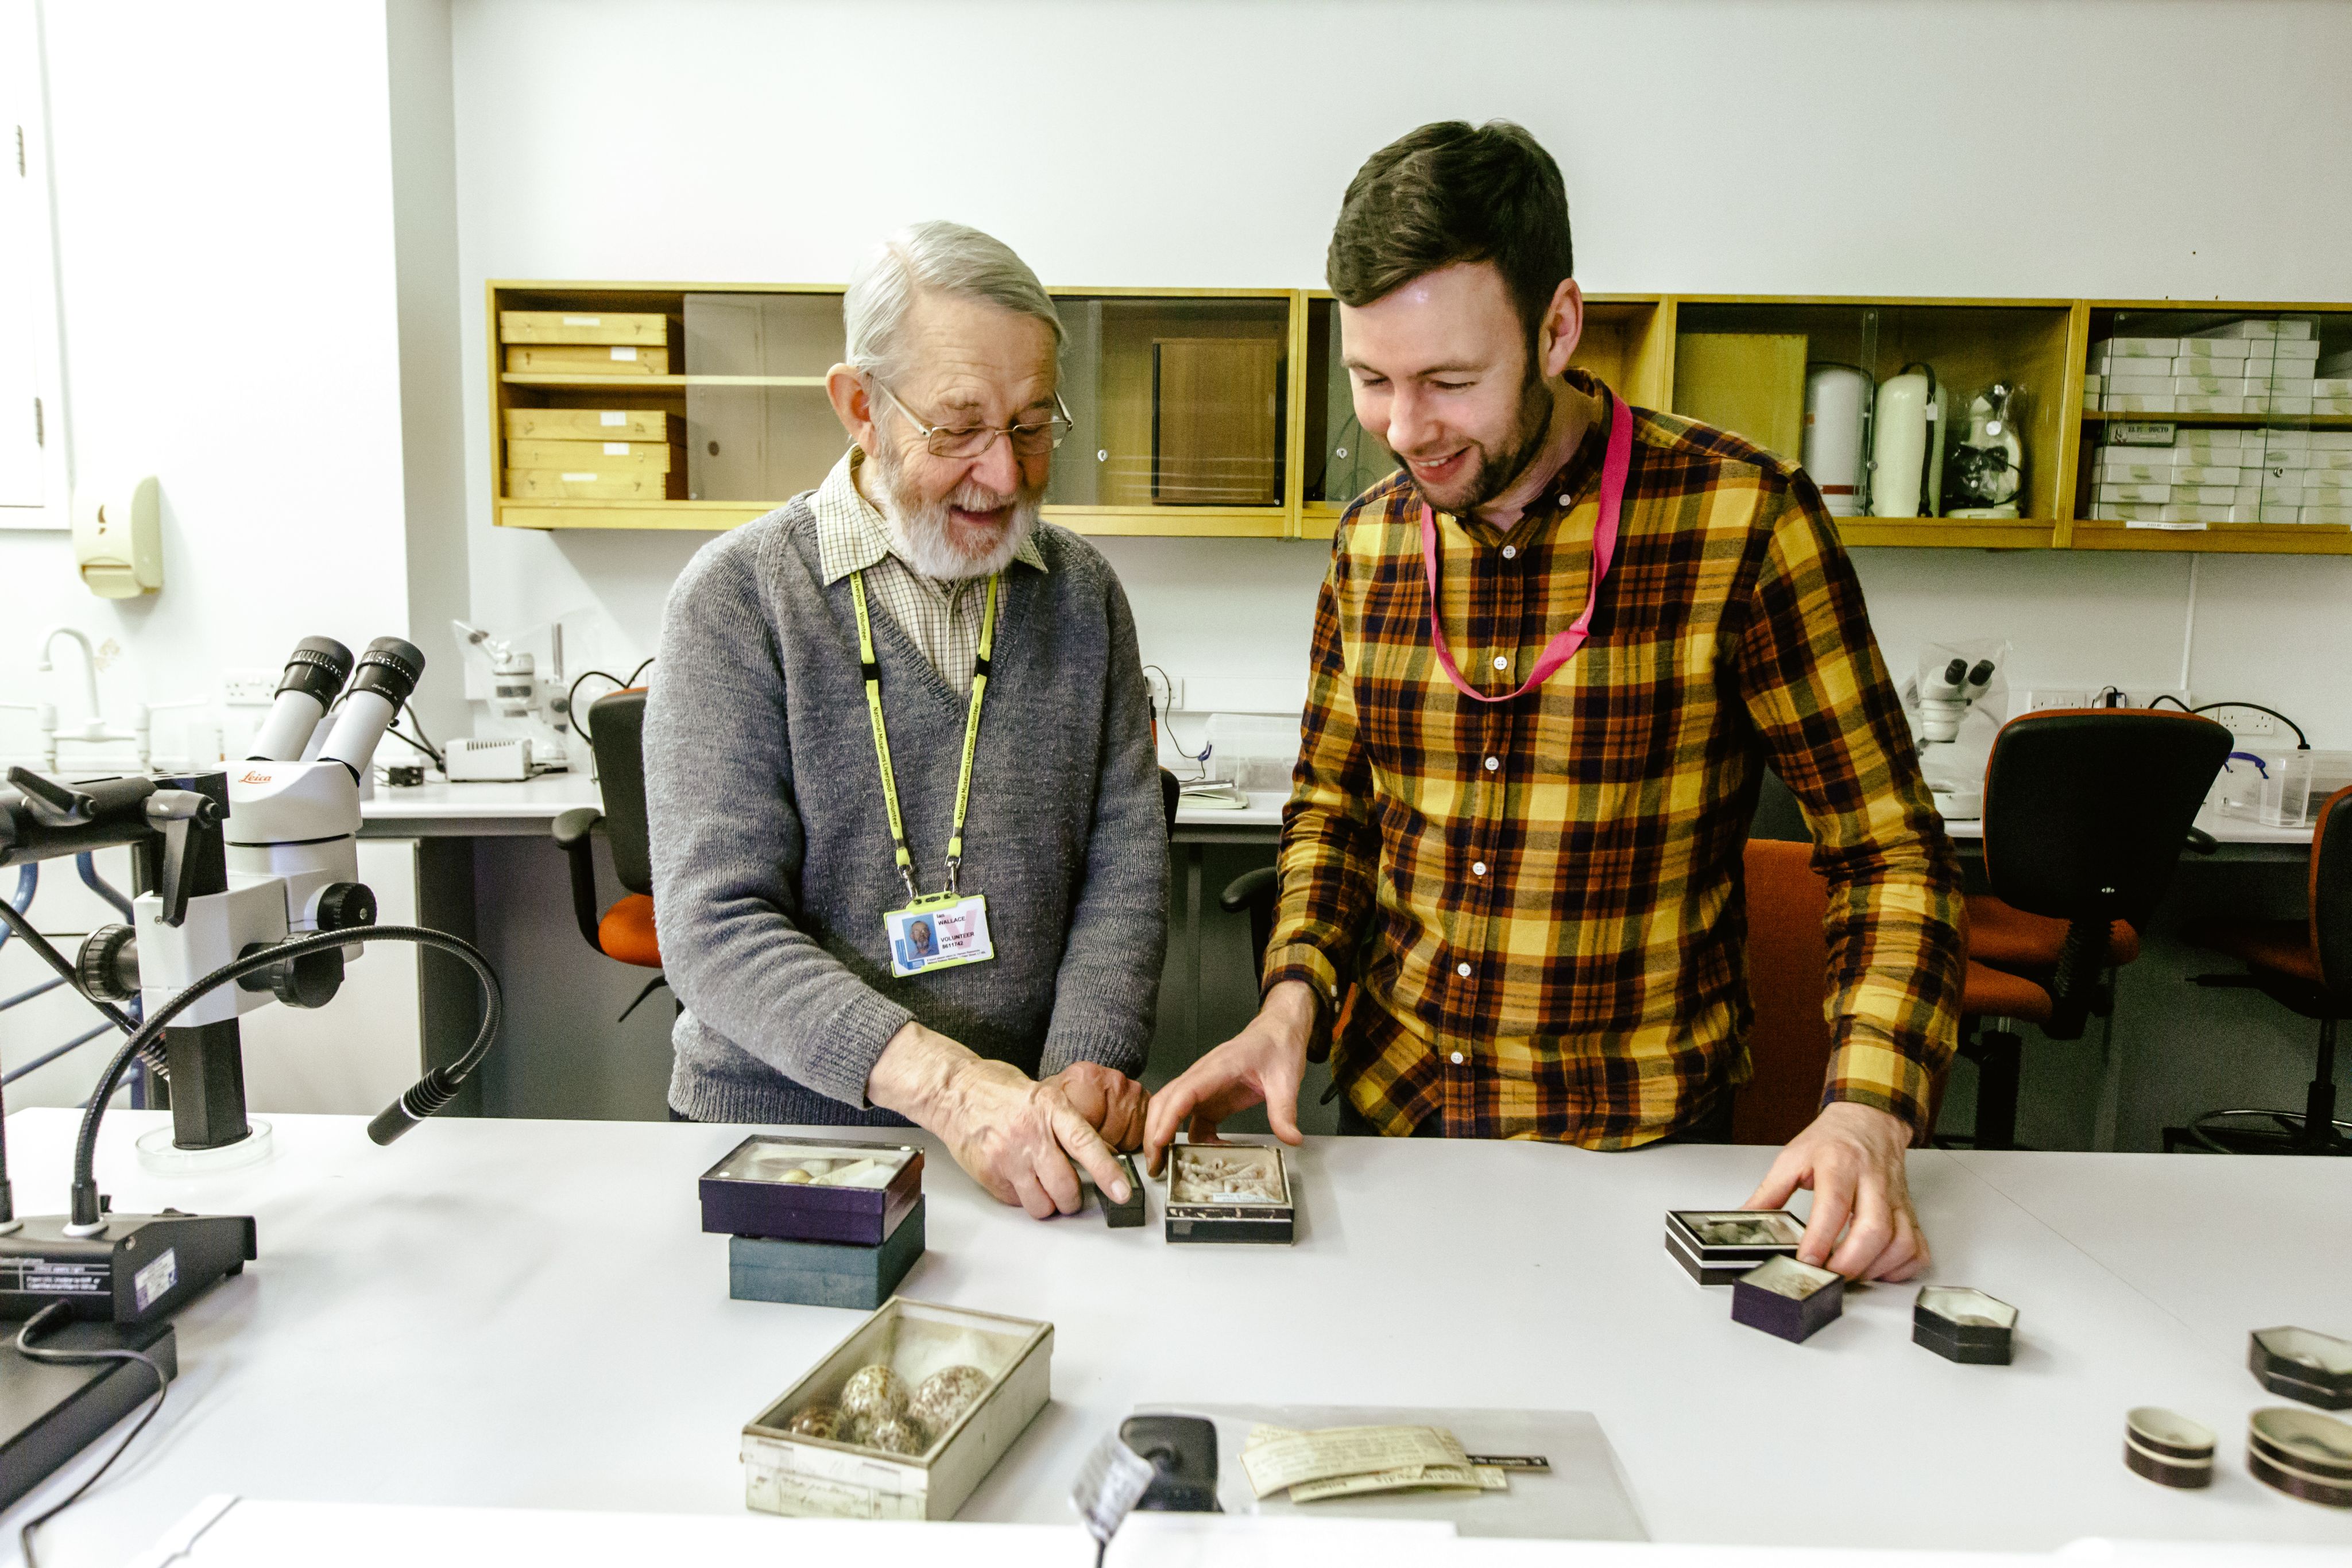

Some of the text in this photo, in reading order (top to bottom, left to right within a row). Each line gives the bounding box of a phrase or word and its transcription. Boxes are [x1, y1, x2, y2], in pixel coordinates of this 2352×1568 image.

[854, 580, 864, 607] Liverpool
[873, 707, 883, 733] National
[970, 702, 980, 731] Volunteer
[877, 733, 887, 762] Museums
[965, 736, 974, 764] Liverpool
[238, 771, 272, 784] Leica
[883, 763, 893, 792] Liverpool
[961, 765, 970, 793] Museums
[889, 796, 898, 827] Volunteer
[957, 795, 966, 820] National
[938, 916, 966, 926] WALLACE
[941, 931, 974, 942] VOLUNTEER
[942, 941, 964, 949] 8611742
